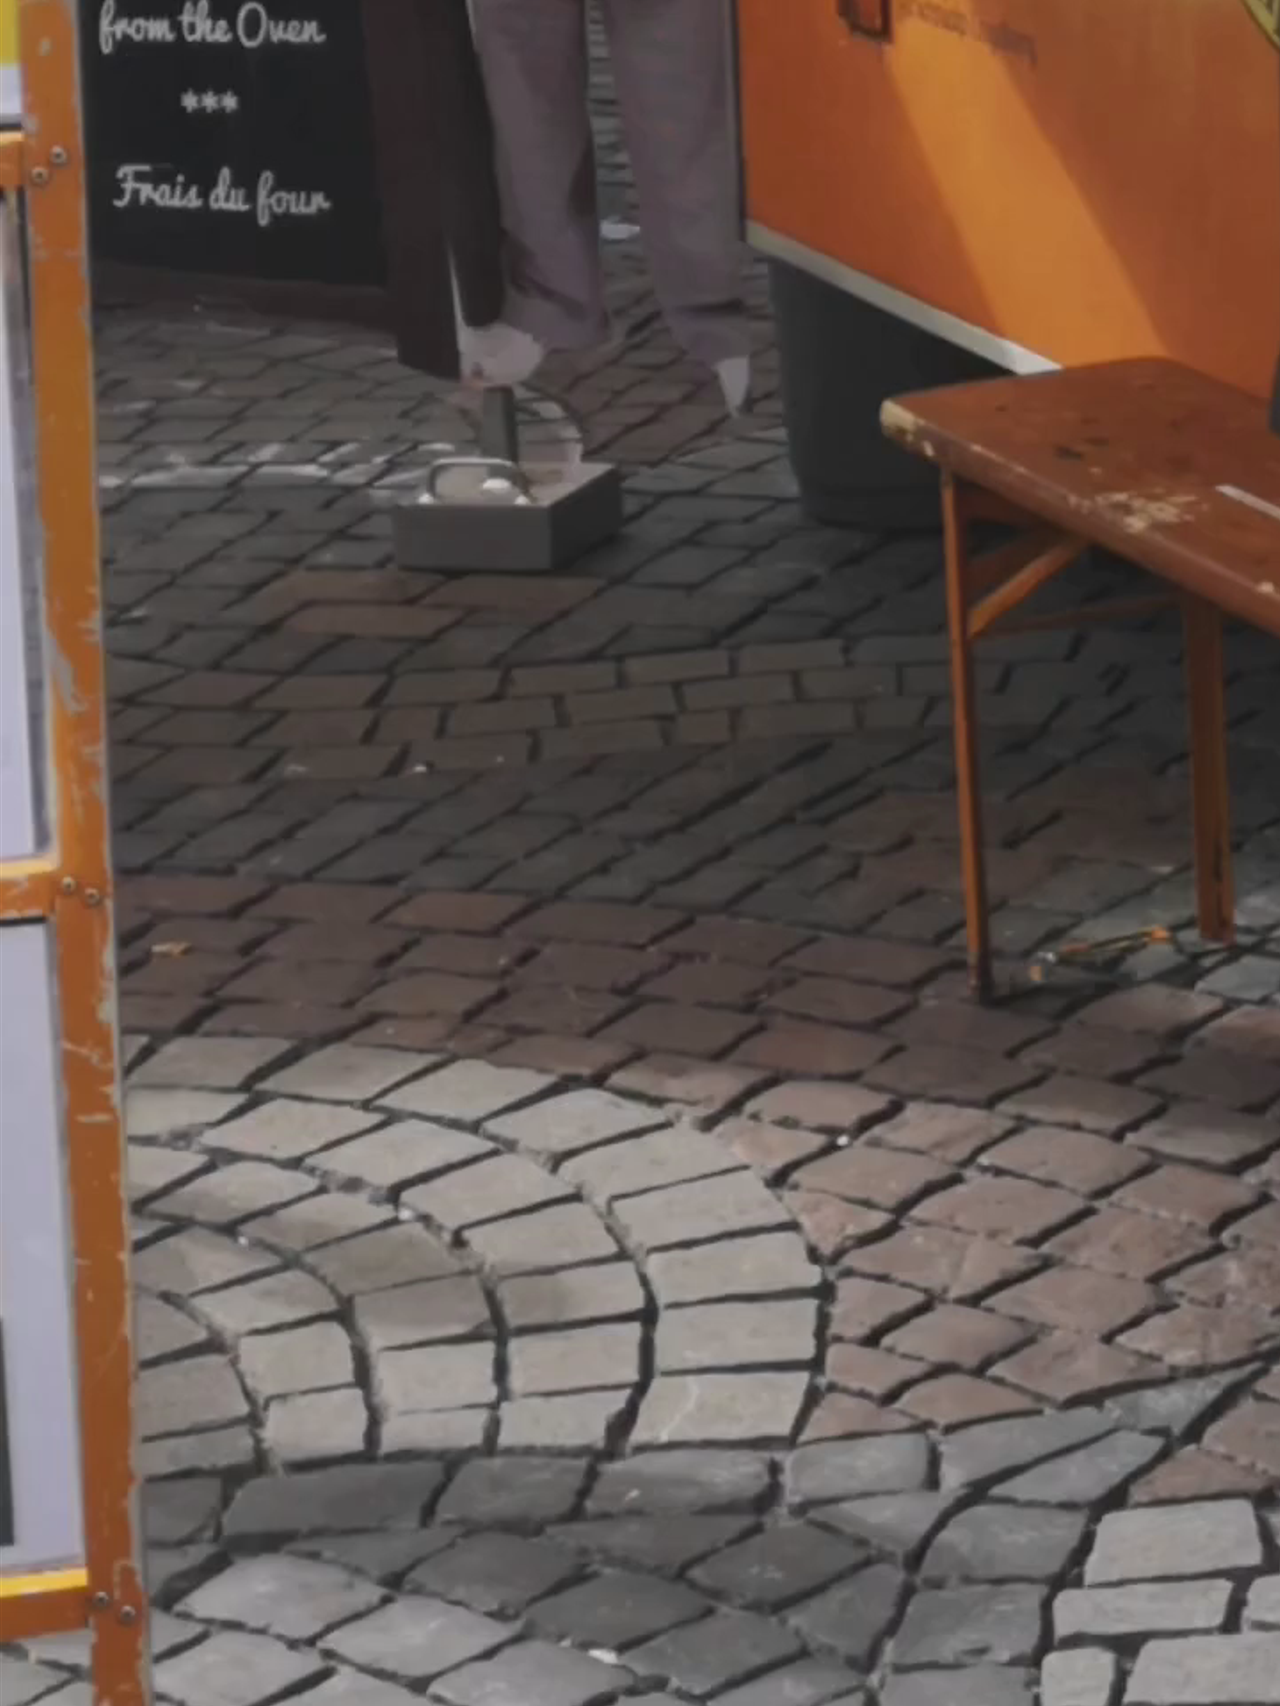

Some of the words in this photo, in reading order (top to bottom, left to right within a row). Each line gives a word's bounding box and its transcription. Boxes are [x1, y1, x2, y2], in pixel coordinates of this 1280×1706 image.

[99, 0, 177, 56] from
[178, 0, 234, 44] the
[237, 2, 328, 49] Oven
[113, 165, 204, 210] Frais
[209, 167, 252, 213] du
[257, 171, 332, 228] four
